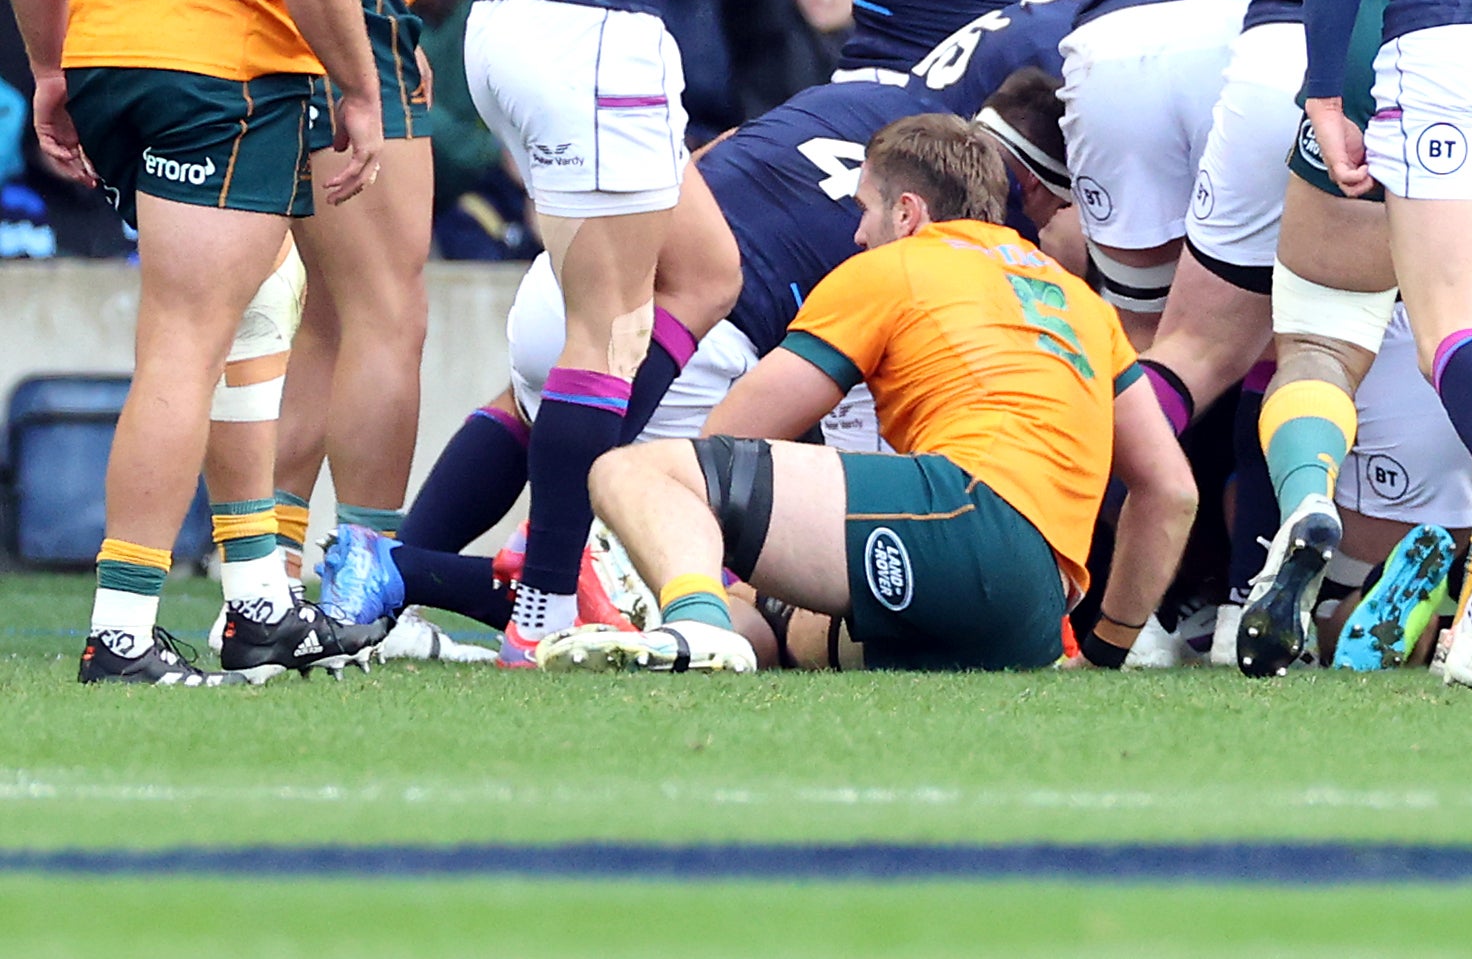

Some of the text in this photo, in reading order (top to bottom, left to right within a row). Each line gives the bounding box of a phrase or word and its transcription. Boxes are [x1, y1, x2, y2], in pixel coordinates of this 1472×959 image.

[796, 137, 867, 201] 4
[1429, 140, 1456, 158] BT
[1006, 273, 1095, 380] 5
[1375, 466, 1398, 487] BT
[874, 548, 894, 597] ROVER
[886, 545, 904, 588] LAND
